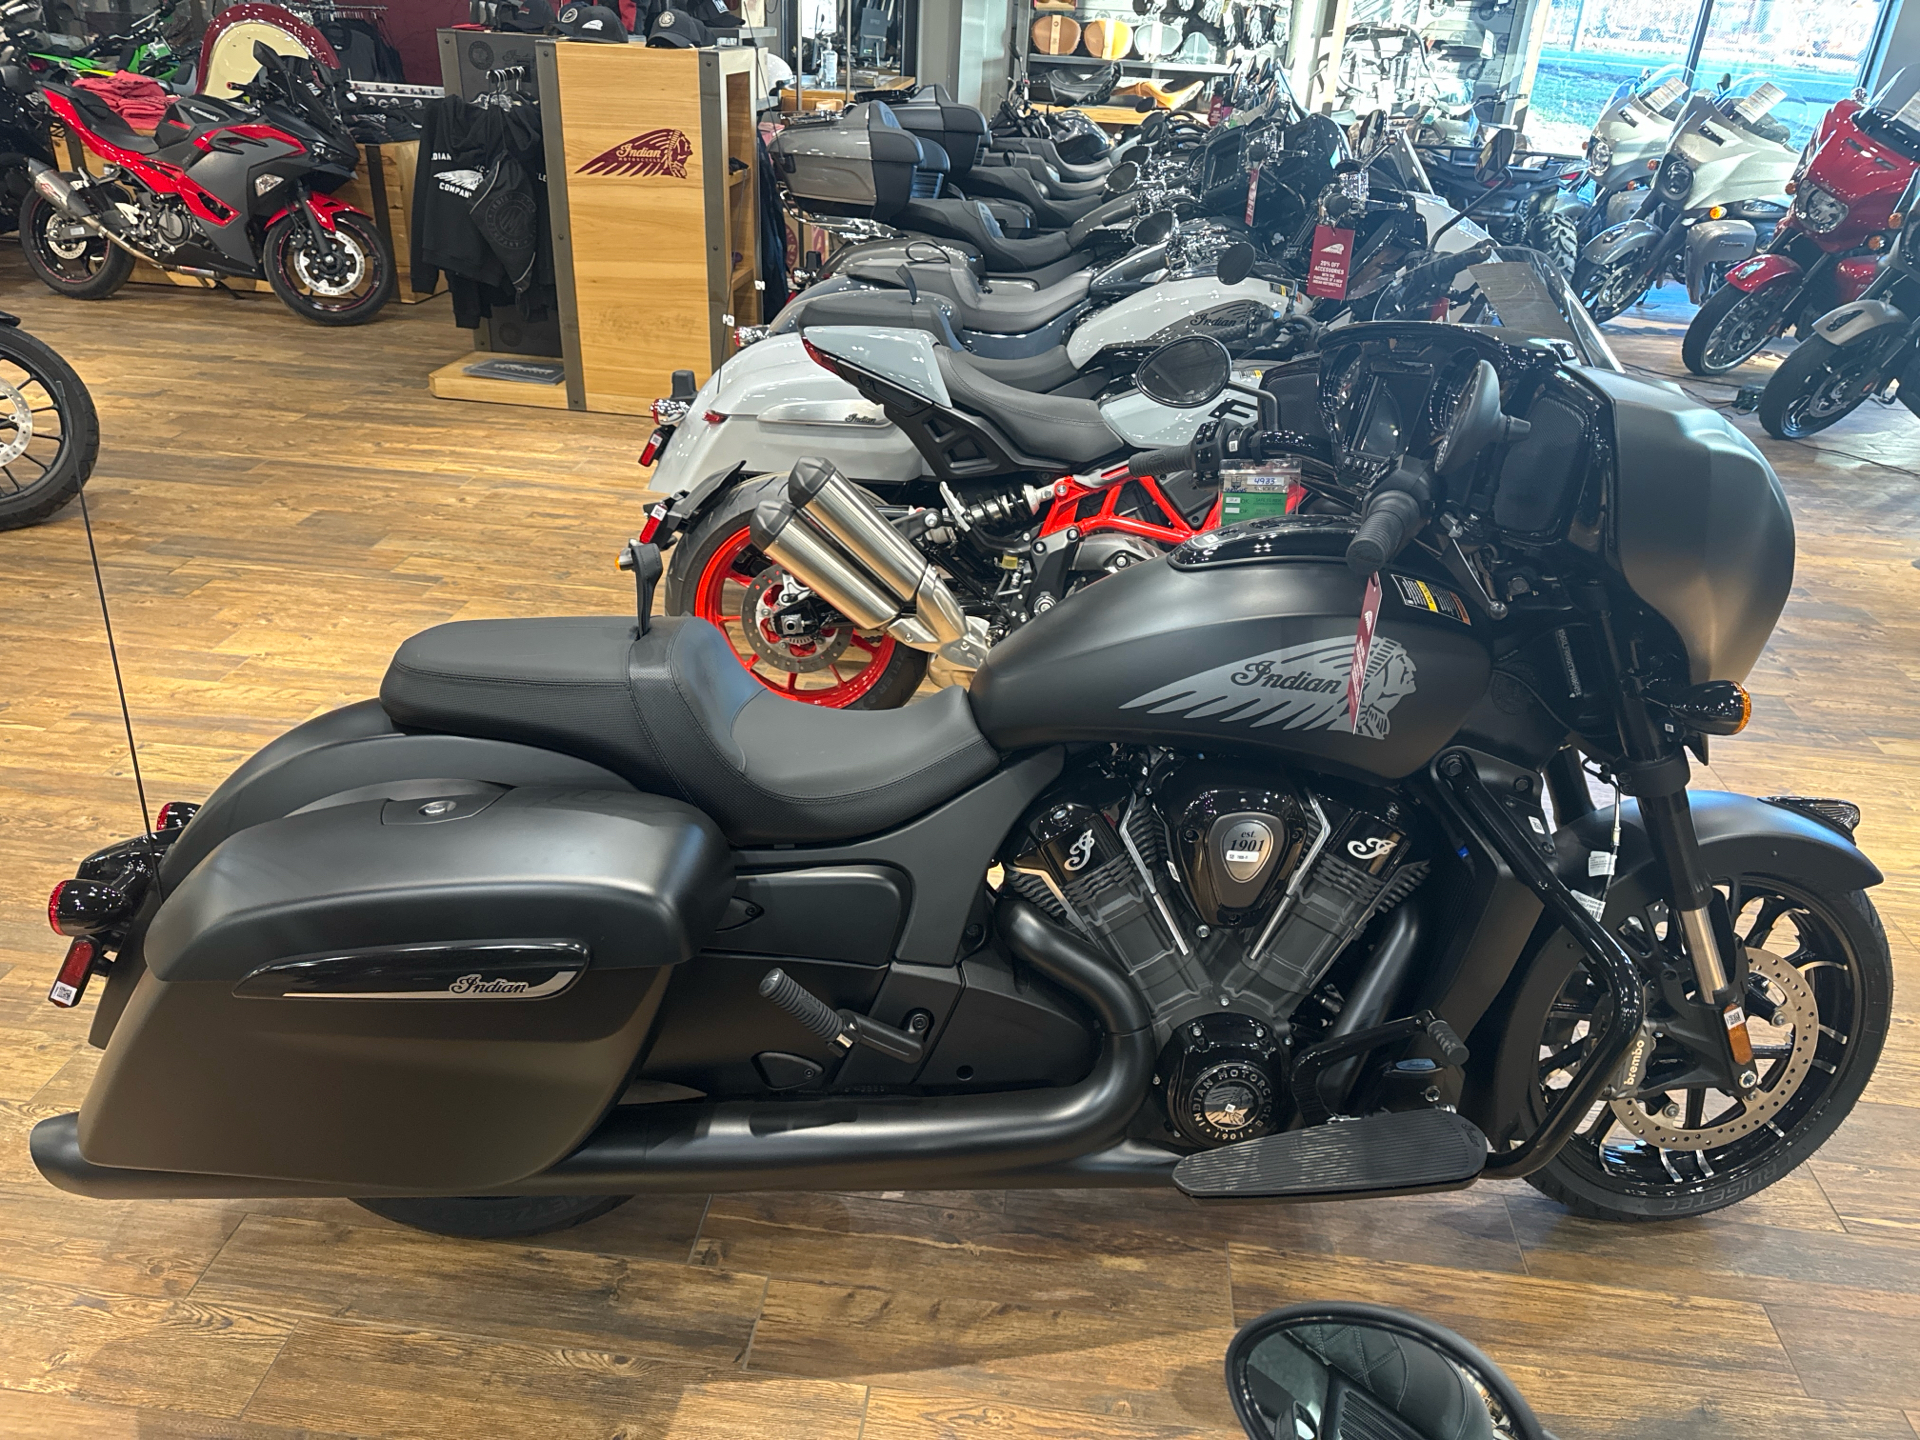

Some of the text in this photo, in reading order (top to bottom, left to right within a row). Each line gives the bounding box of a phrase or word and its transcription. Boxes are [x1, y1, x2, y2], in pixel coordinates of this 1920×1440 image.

[616, 143, 661, 158] Indian
[438, 182, 473, 199] COMPAN
[1314, 266, 1344, 275] ACCESSORIES
[1190, 313, 1237, 327] Indian
[845, 413, 876, 424] Indian
[1231, 660, 1341, 694] Indian
[1230, 839, 1265, 852] 1901
[450, 975, 528, 994] Indian
[1624, 1040, 1645, 1086] brembo
[1193, 1078, 1214, 1127] INDIAN
[1214, 1131, 1244, 1140] 1901
